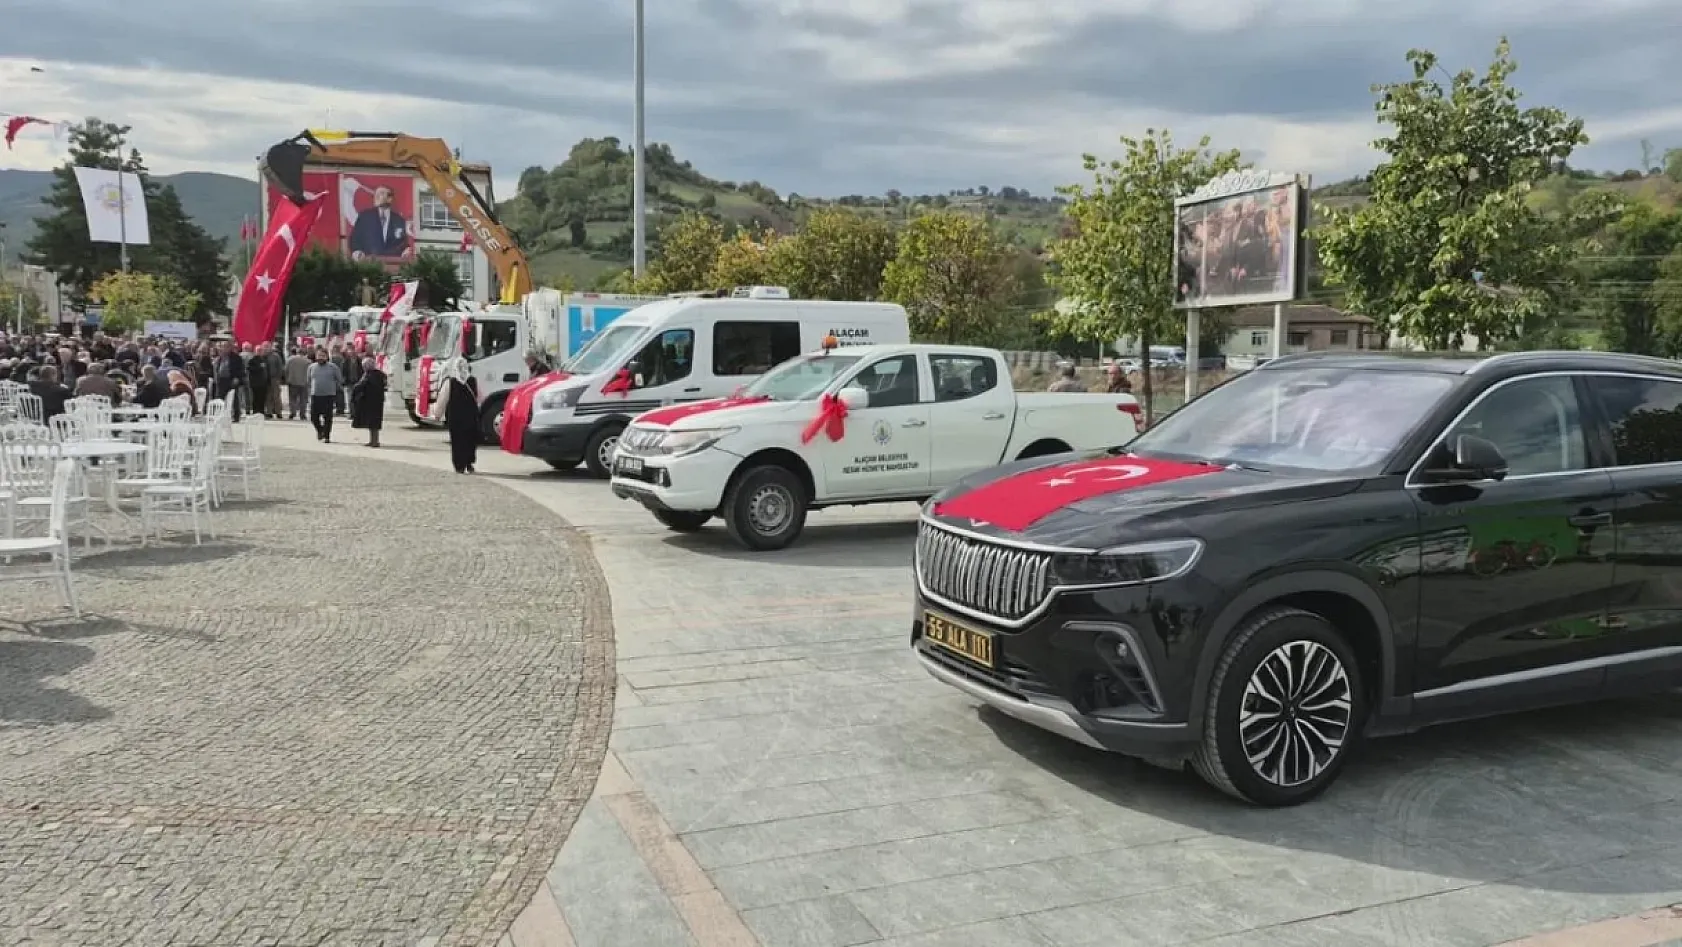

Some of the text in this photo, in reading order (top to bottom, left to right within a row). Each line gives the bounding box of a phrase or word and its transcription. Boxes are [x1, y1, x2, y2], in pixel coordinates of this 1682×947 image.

[459, 205, 501, 251] CASE
[829, 329, 870, 338] ALAÇAM
[926, 614, 943, 640] 55
[947, 625, 968, 651] ALA
